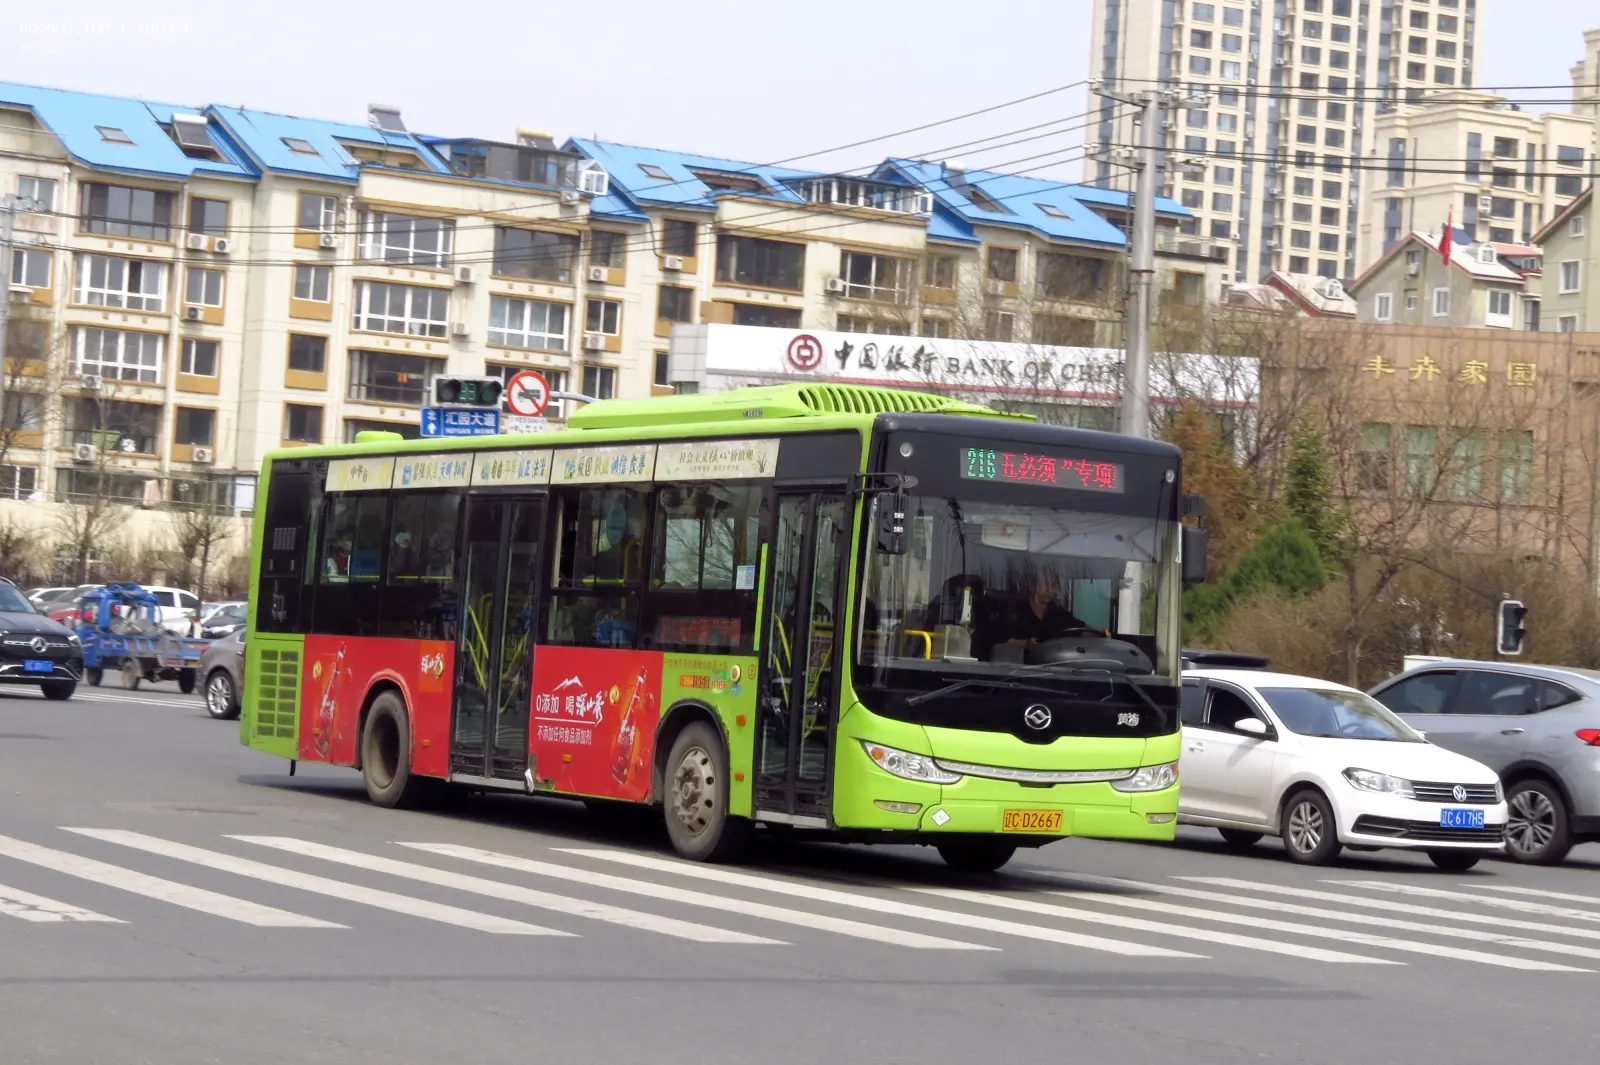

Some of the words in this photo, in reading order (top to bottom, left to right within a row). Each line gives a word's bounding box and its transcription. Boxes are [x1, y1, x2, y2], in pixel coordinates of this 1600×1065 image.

[835, 340, 939, 374] 中国银行
[946, 357, 1015, 379] BANK
[1362, 355, 1537, 387] 丰卉家园
[445, 411, 497, 427] 汇园大道
[967, 448, 997, 479] 216
[1117, 712, 1140, 727] 黄海
[537, 725, 593, 746] 不添加任何食品添加剂
